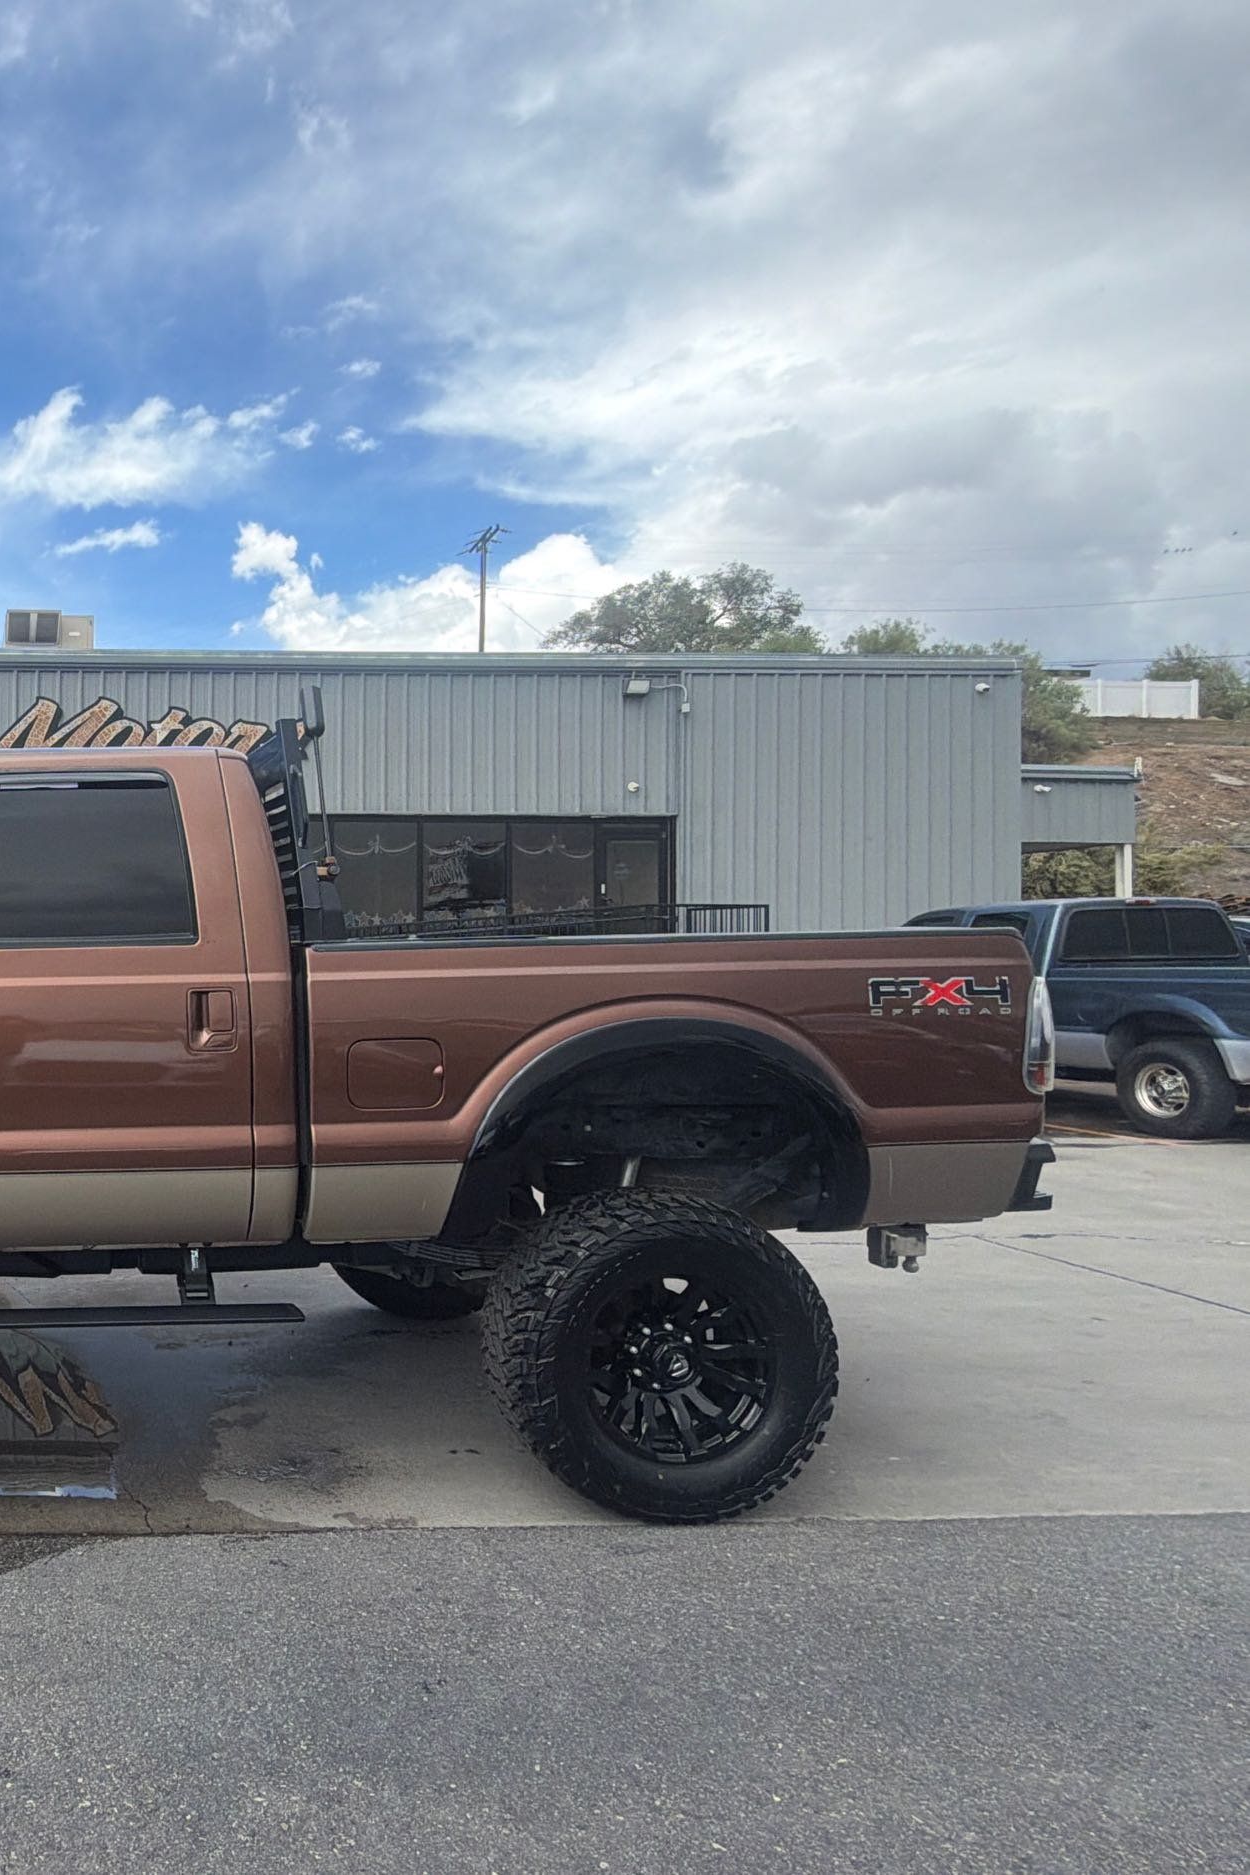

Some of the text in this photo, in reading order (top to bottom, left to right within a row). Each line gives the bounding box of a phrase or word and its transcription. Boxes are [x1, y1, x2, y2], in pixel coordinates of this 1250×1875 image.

[868, 976, 1011, 1006] FX4
[870, 1007, 1012, 1016] OFF ROAD
